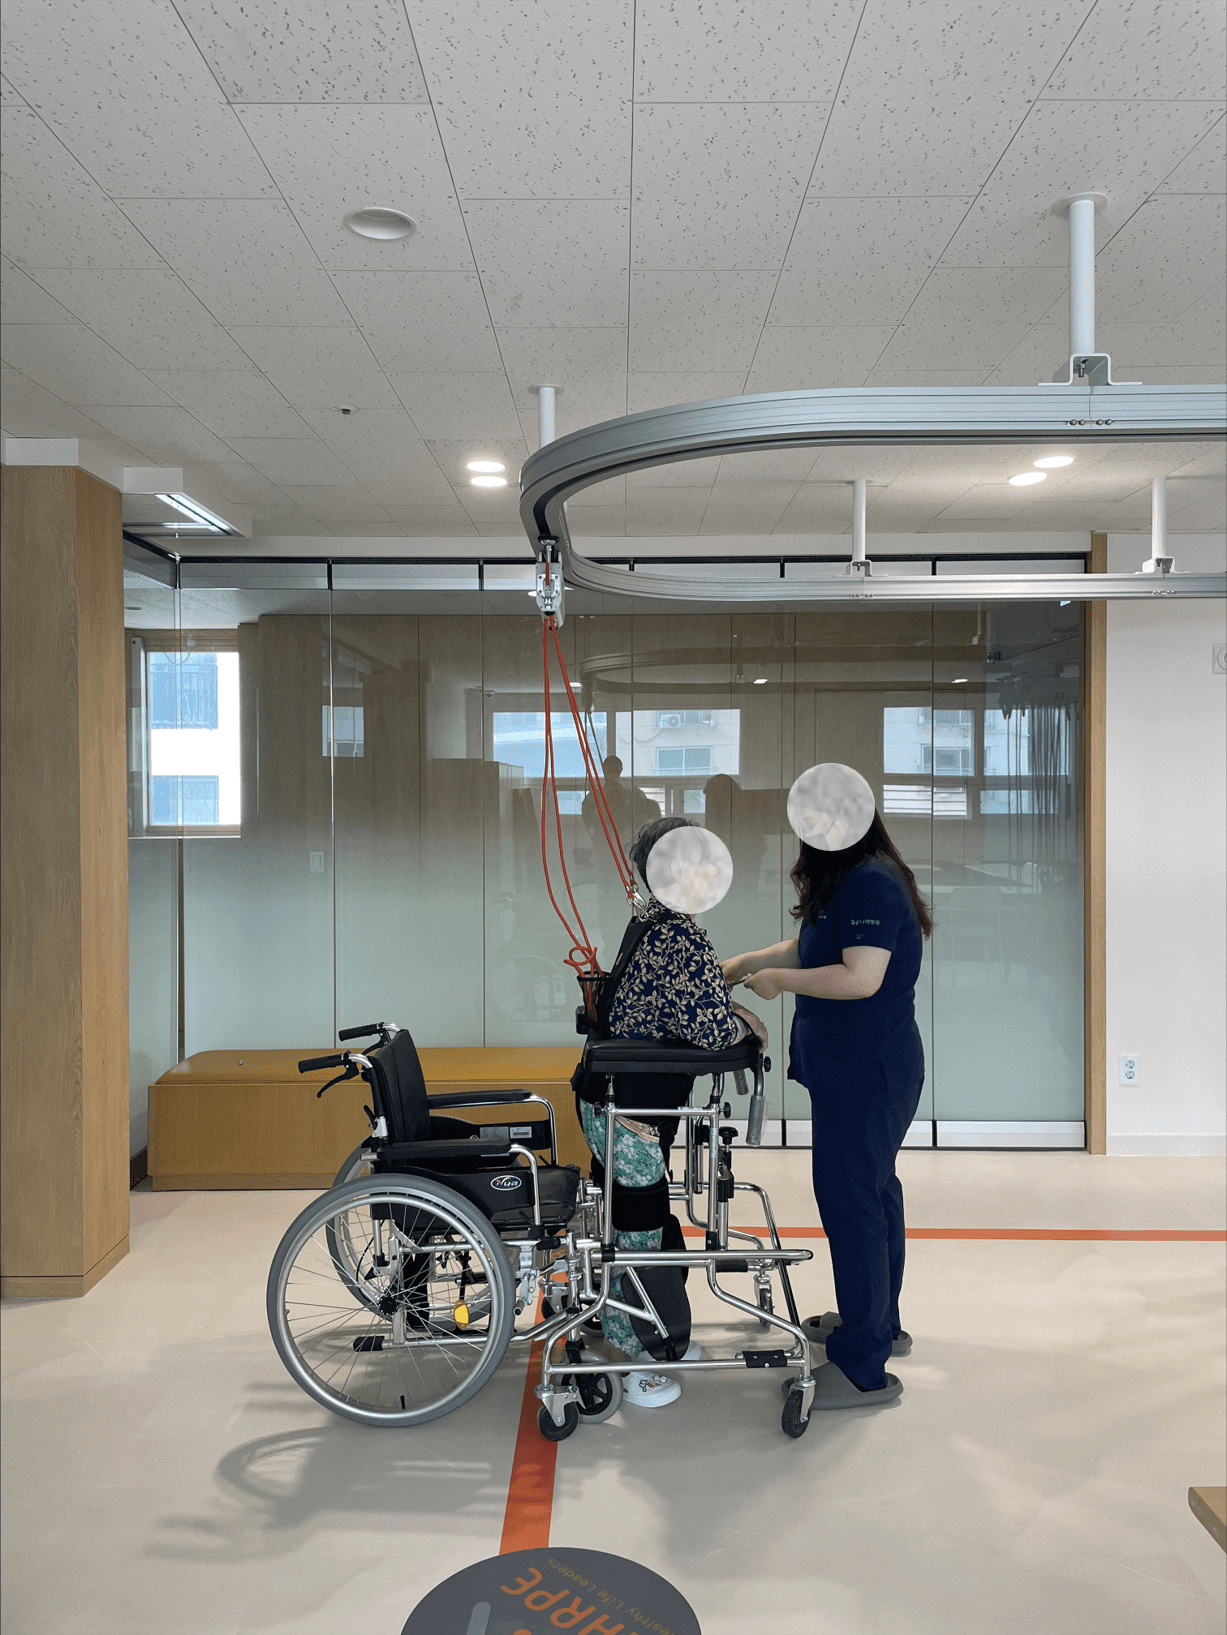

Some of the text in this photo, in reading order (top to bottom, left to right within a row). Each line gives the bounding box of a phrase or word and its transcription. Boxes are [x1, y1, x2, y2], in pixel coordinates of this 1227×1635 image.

[500, 1567, 639, 1635] HRPE
[547, 1558, 675, 1635] ealthy Life Leaders
